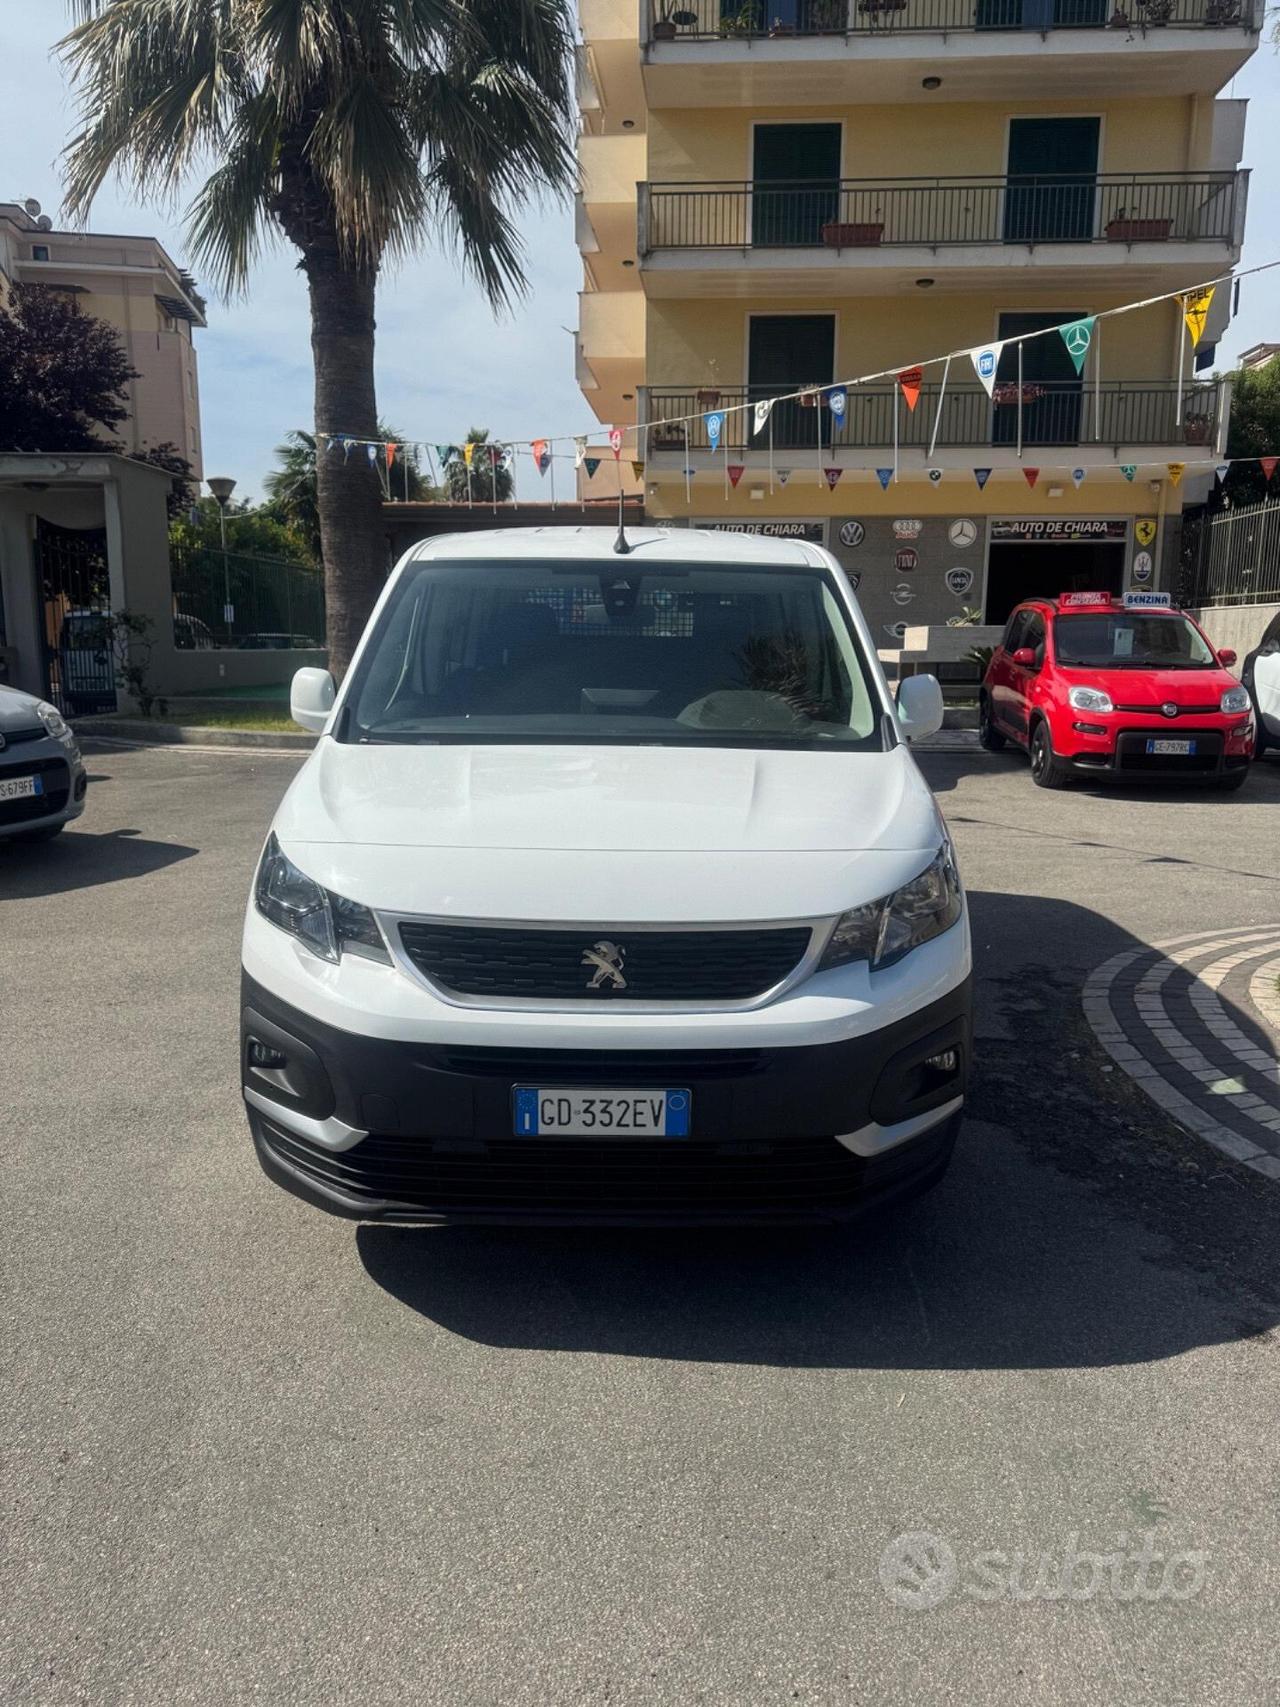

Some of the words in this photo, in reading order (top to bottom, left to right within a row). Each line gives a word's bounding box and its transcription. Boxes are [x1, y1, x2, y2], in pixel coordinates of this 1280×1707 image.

[746, 524, 762, 535] DE
[763, 524, 806, 535] CHIARA
[1010, 522, 1044, 533] AUTO
[1046, 522, 1063, 533] DE
[1064, 522, 1108, 533] CHIARA
[1127, 595, 1168, 604] BENZINA
[540, 1098, 572, 1126] GD
[581, 1099, 664, 1128] 332EV
